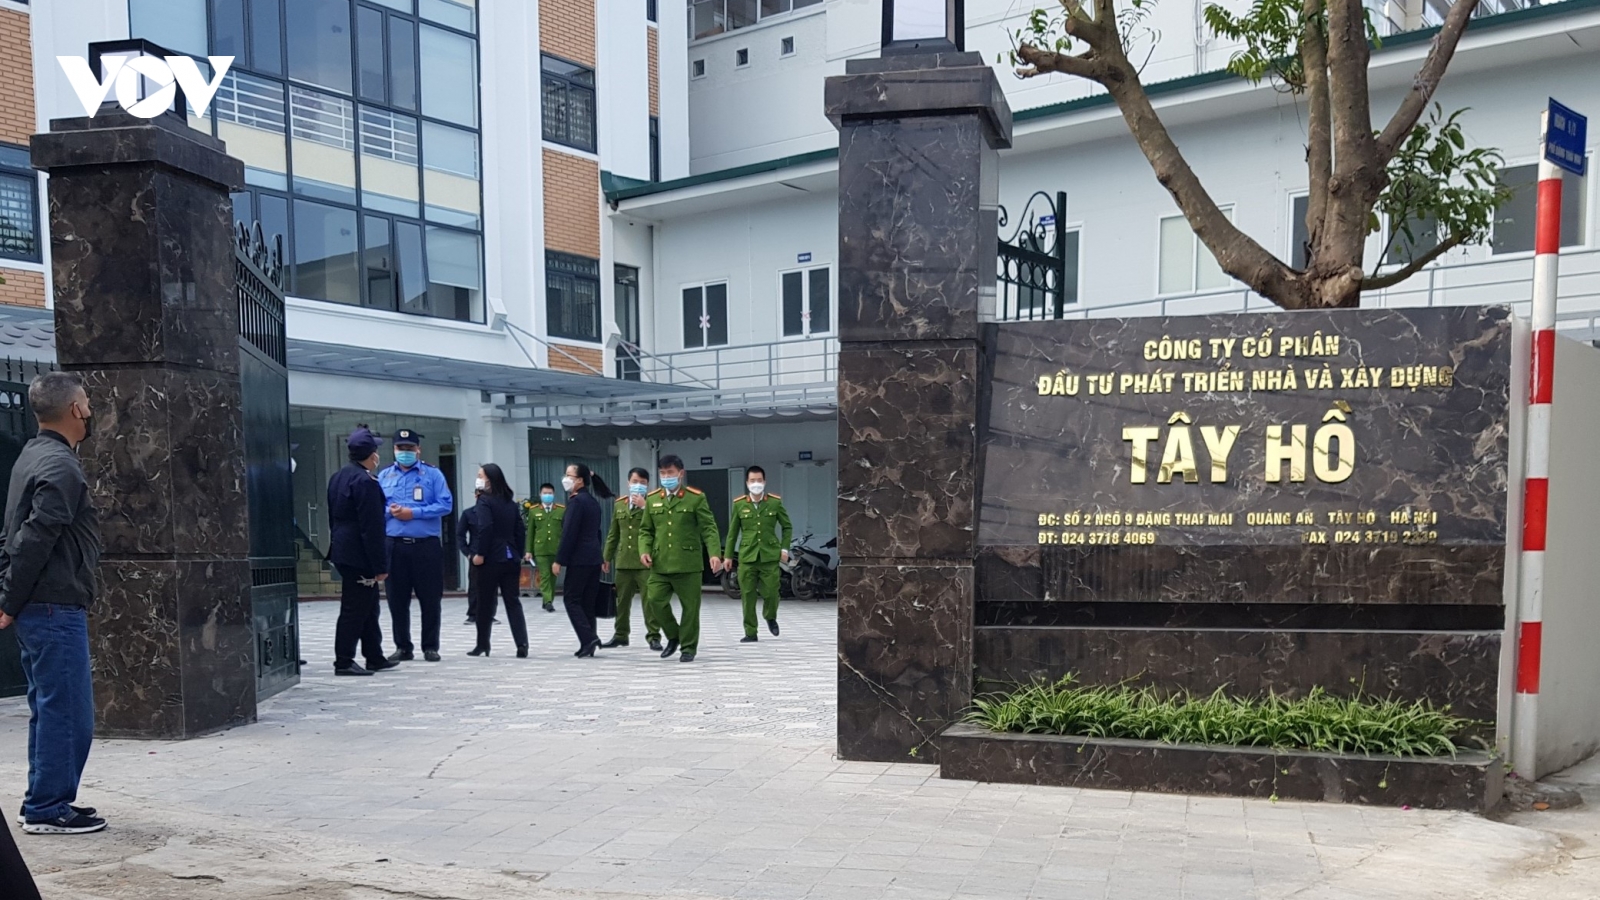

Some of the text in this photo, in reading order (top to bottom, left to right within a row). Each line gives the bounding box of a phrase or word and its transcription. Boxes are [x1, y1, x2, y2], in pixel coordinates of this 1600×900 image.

[1143, 334, 1202, 360] CÔNG
[1209, 338, 1236, 358] TY
[1242, 327, 1274, 357] CỔ
[1037, 361, 1453, 396] ĐẦU TƯ PHÁT TRIỂN NHÀ VÀ XÂY DỰNG
[1122, 410, 1241, 484] TÂY
[1063, 509, 1081, 526] SỐ
[1083, 513, 1092, 526] 2
[1095, 510, 1120, 526] NGÕ
[1124, 513, 1133, 526] 9
[1136, 511, 1171, 528] ĐẶNG
[1174, 513, 1204, 525] THAI
[1208, 513, 1233, 525] MAI
[1295, 512, 1314, 525] AN
[1327, 509, 1353, 525] TÂY
[1038, 532, 1155, 545] ĐT: 024 3718 4069
[1334, 530, 1360, 544] 024
[1364, 530, 1398, 544] 3719
